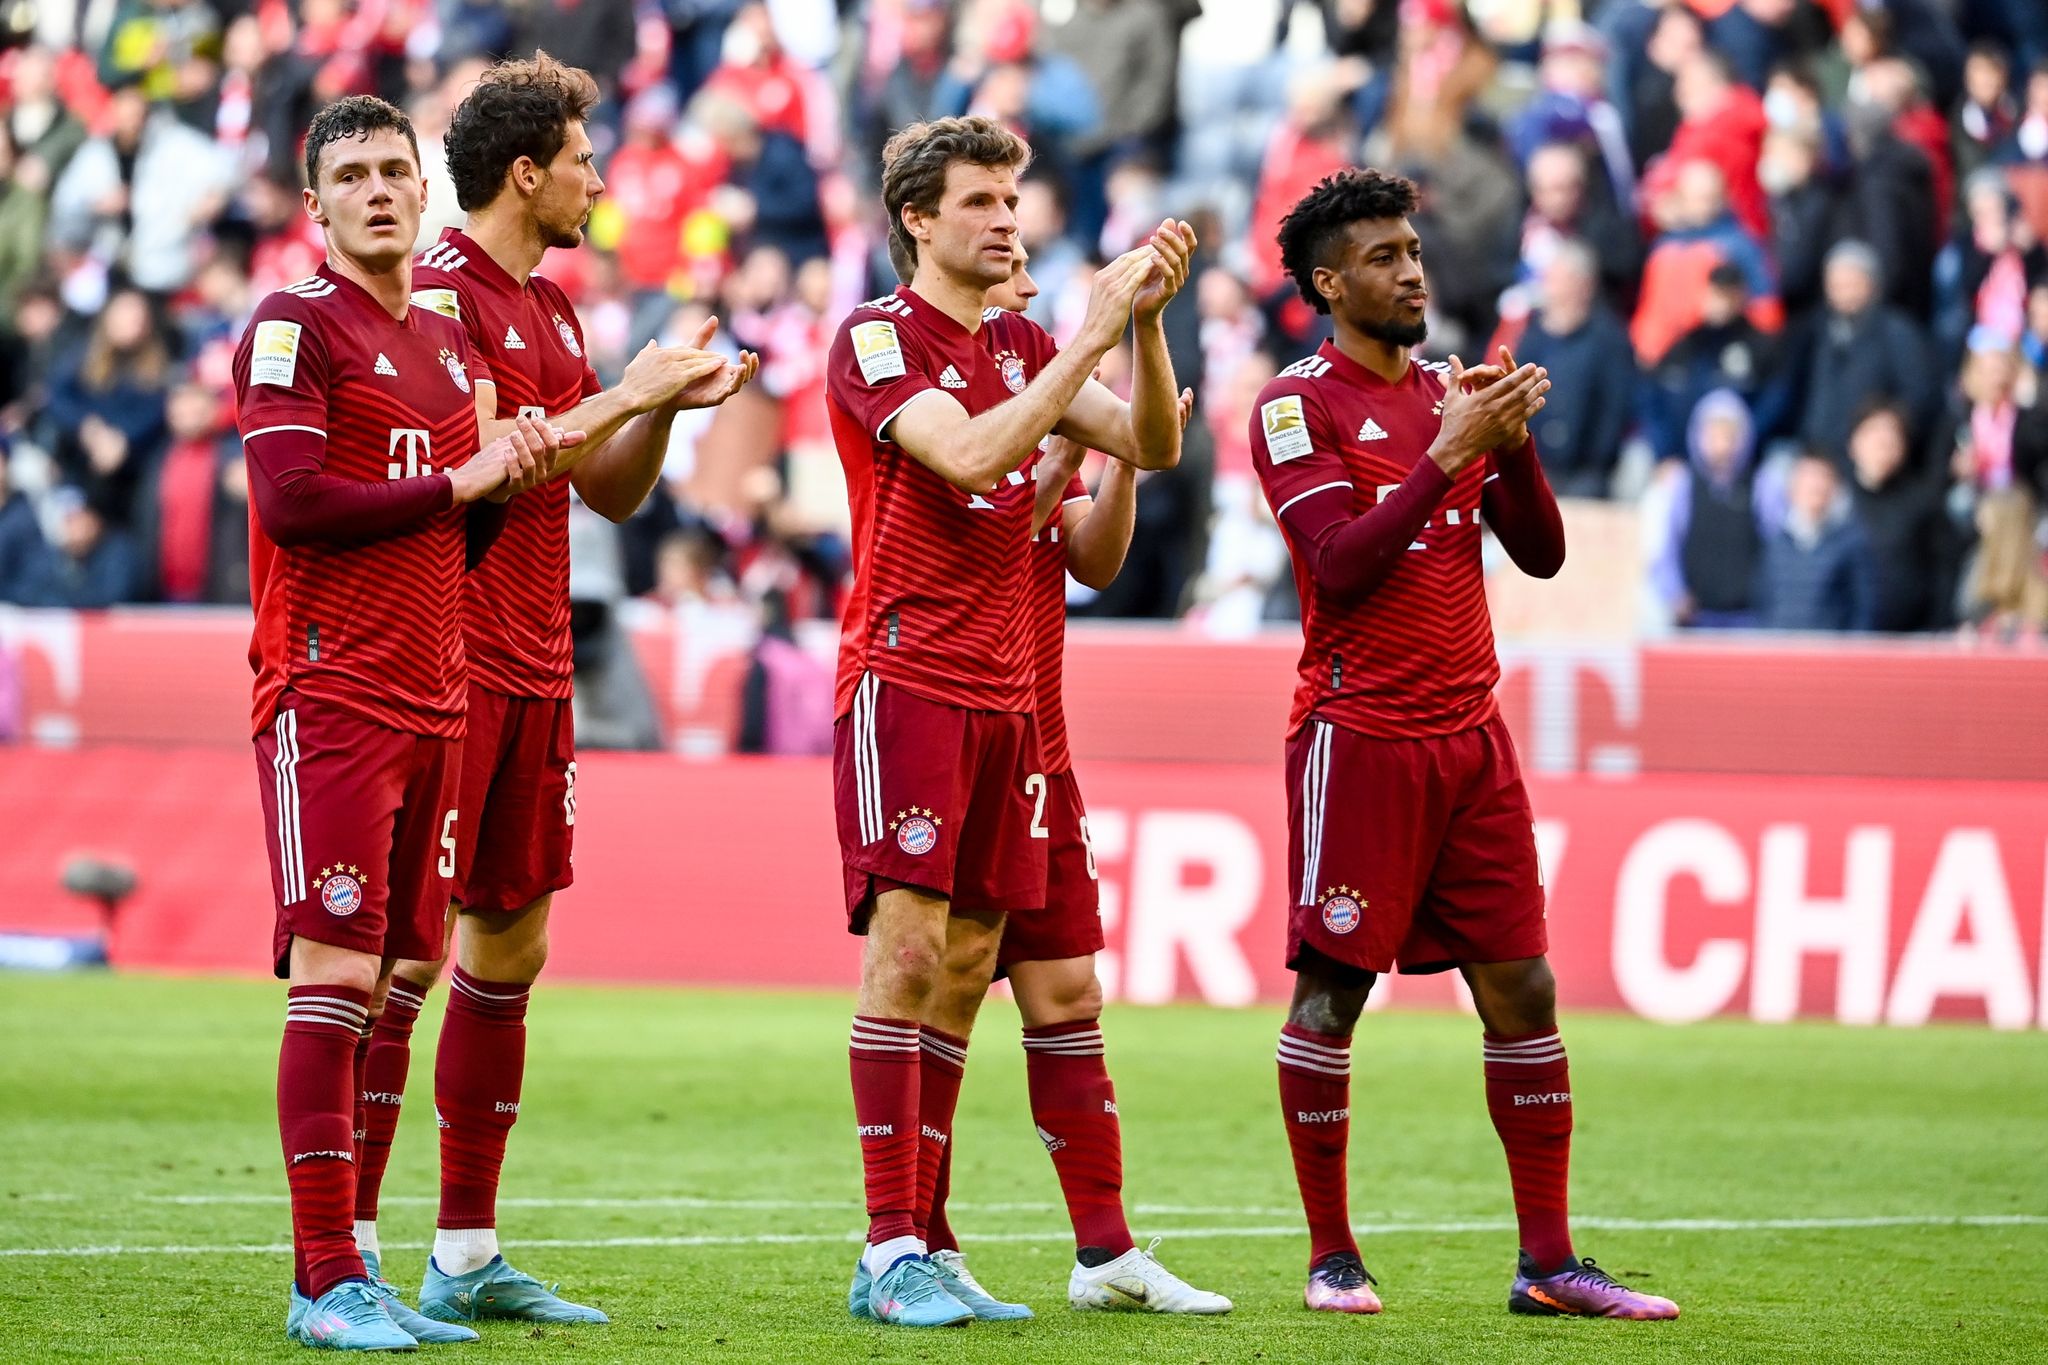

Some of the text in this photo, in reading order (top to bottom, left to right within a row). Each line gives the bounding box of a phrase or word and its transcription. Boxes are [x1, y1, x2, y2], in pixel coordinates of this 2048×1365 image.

[861, 349, 897, 364] BUNDESLIGA
[1025, 773, 1049, 838] 2
[907, 820, 933, 833] BAYERN
[438, 809, 458, 878] 5
[332, 877, 358, 892] BAYERN
[1334, 899, 1357, 914] BAYERN
[1610, 818, 2048, 1032] CHA
